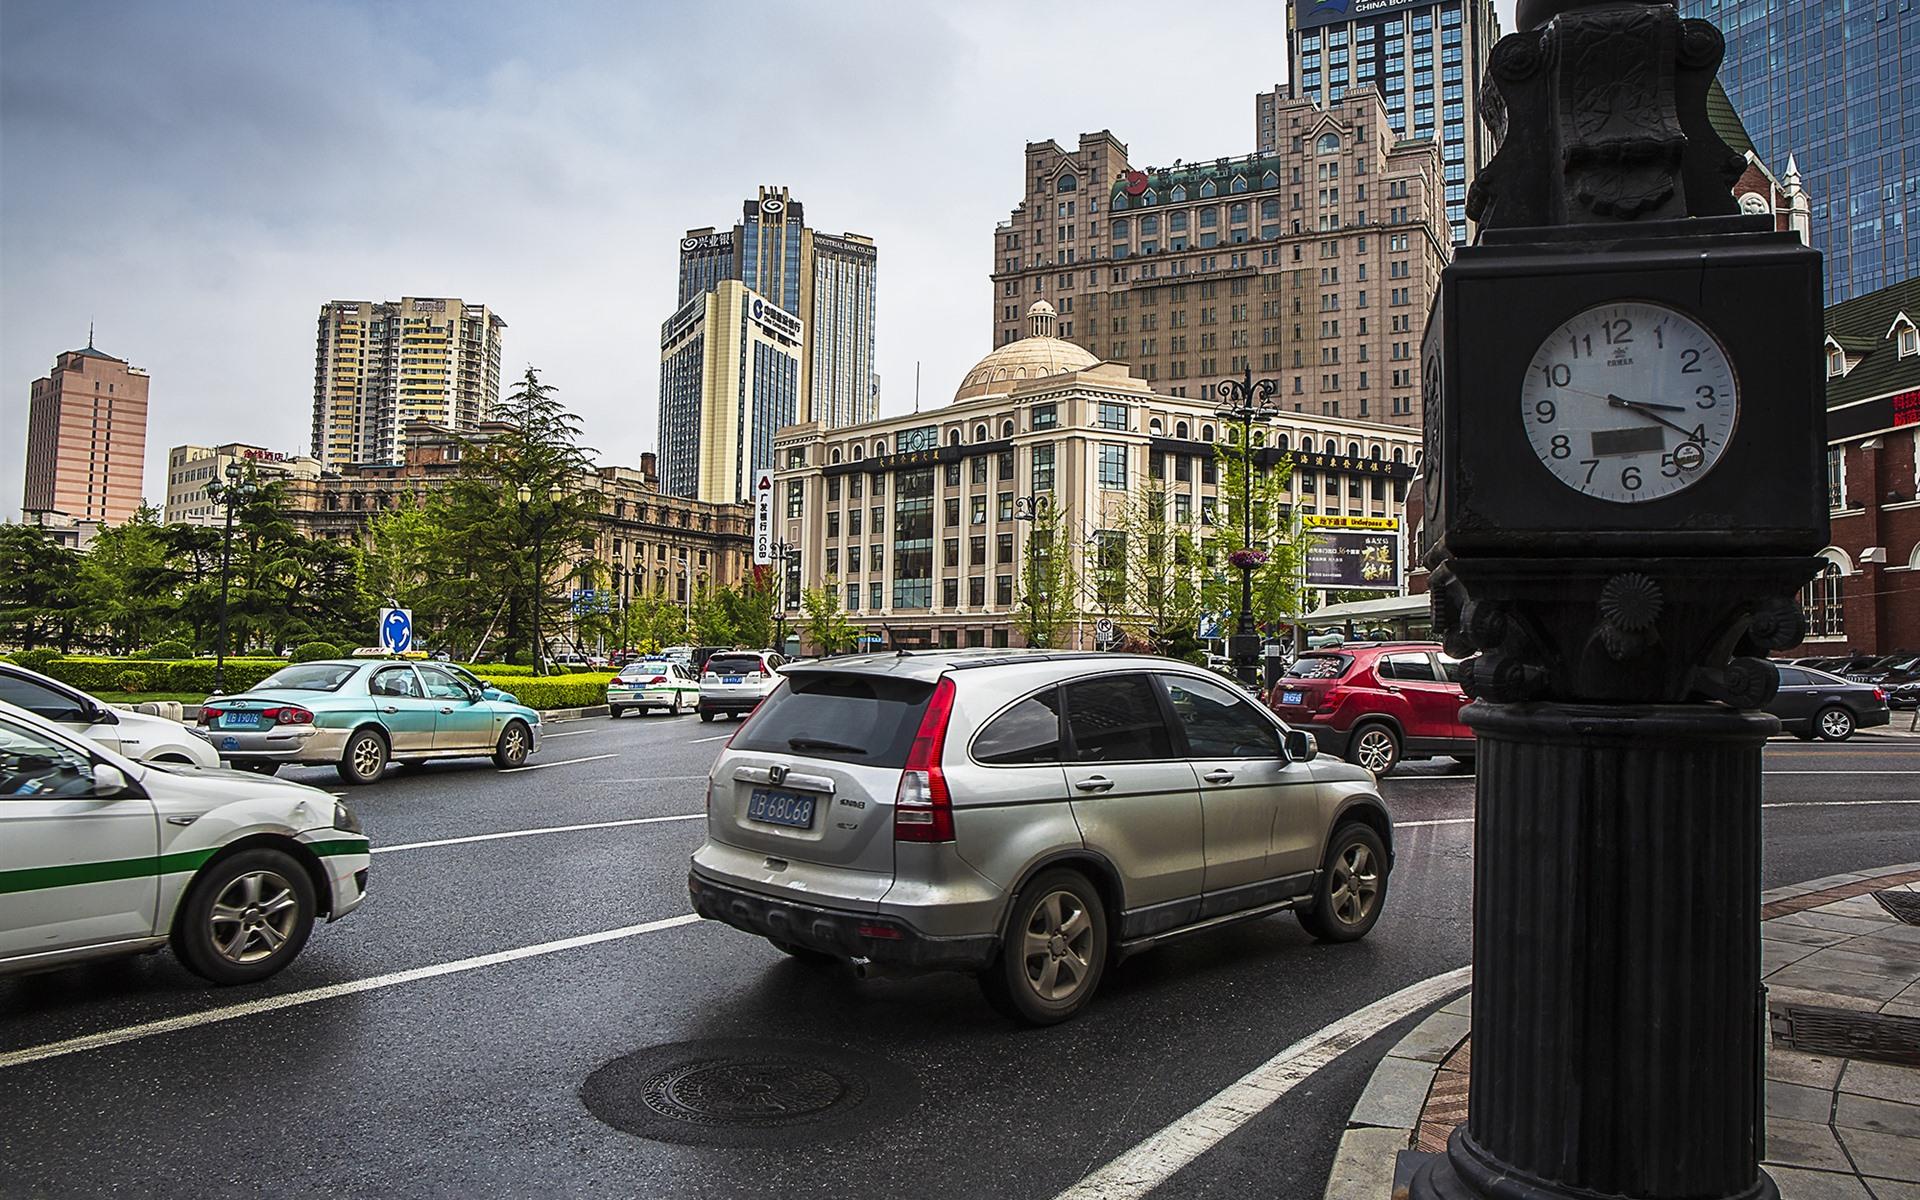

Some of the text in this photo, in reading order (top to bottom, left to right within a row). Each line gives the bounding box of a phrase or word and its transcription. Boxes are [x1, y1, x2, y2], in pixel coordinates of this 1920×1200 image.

[1355, 1, 1387, 12] CHINA
[844, 242, 857, 250] BANK
[1602, 319, 1633, 344] 12
[1654, 325, 1663, 349] 1
[1569, 334, 1592, 359] 11
[1680, 349, 1702, 373] 2
[1543, 364, 1571, 388] 10
[1696, 385, 1716, 409] 3
[1894, 391, 1920, 411] 科技
[1536, 400, 1556, 424] 9
[1894, 408, 1920, 427] 防范
[1551, 434, 1571, 459] 8
[1688, 423, 1709, 448] 4
[1580, 459, 1600, 484] 7
[1661, 453, 1681, 477] 5
[1621, 467, 1642, 490] 6
